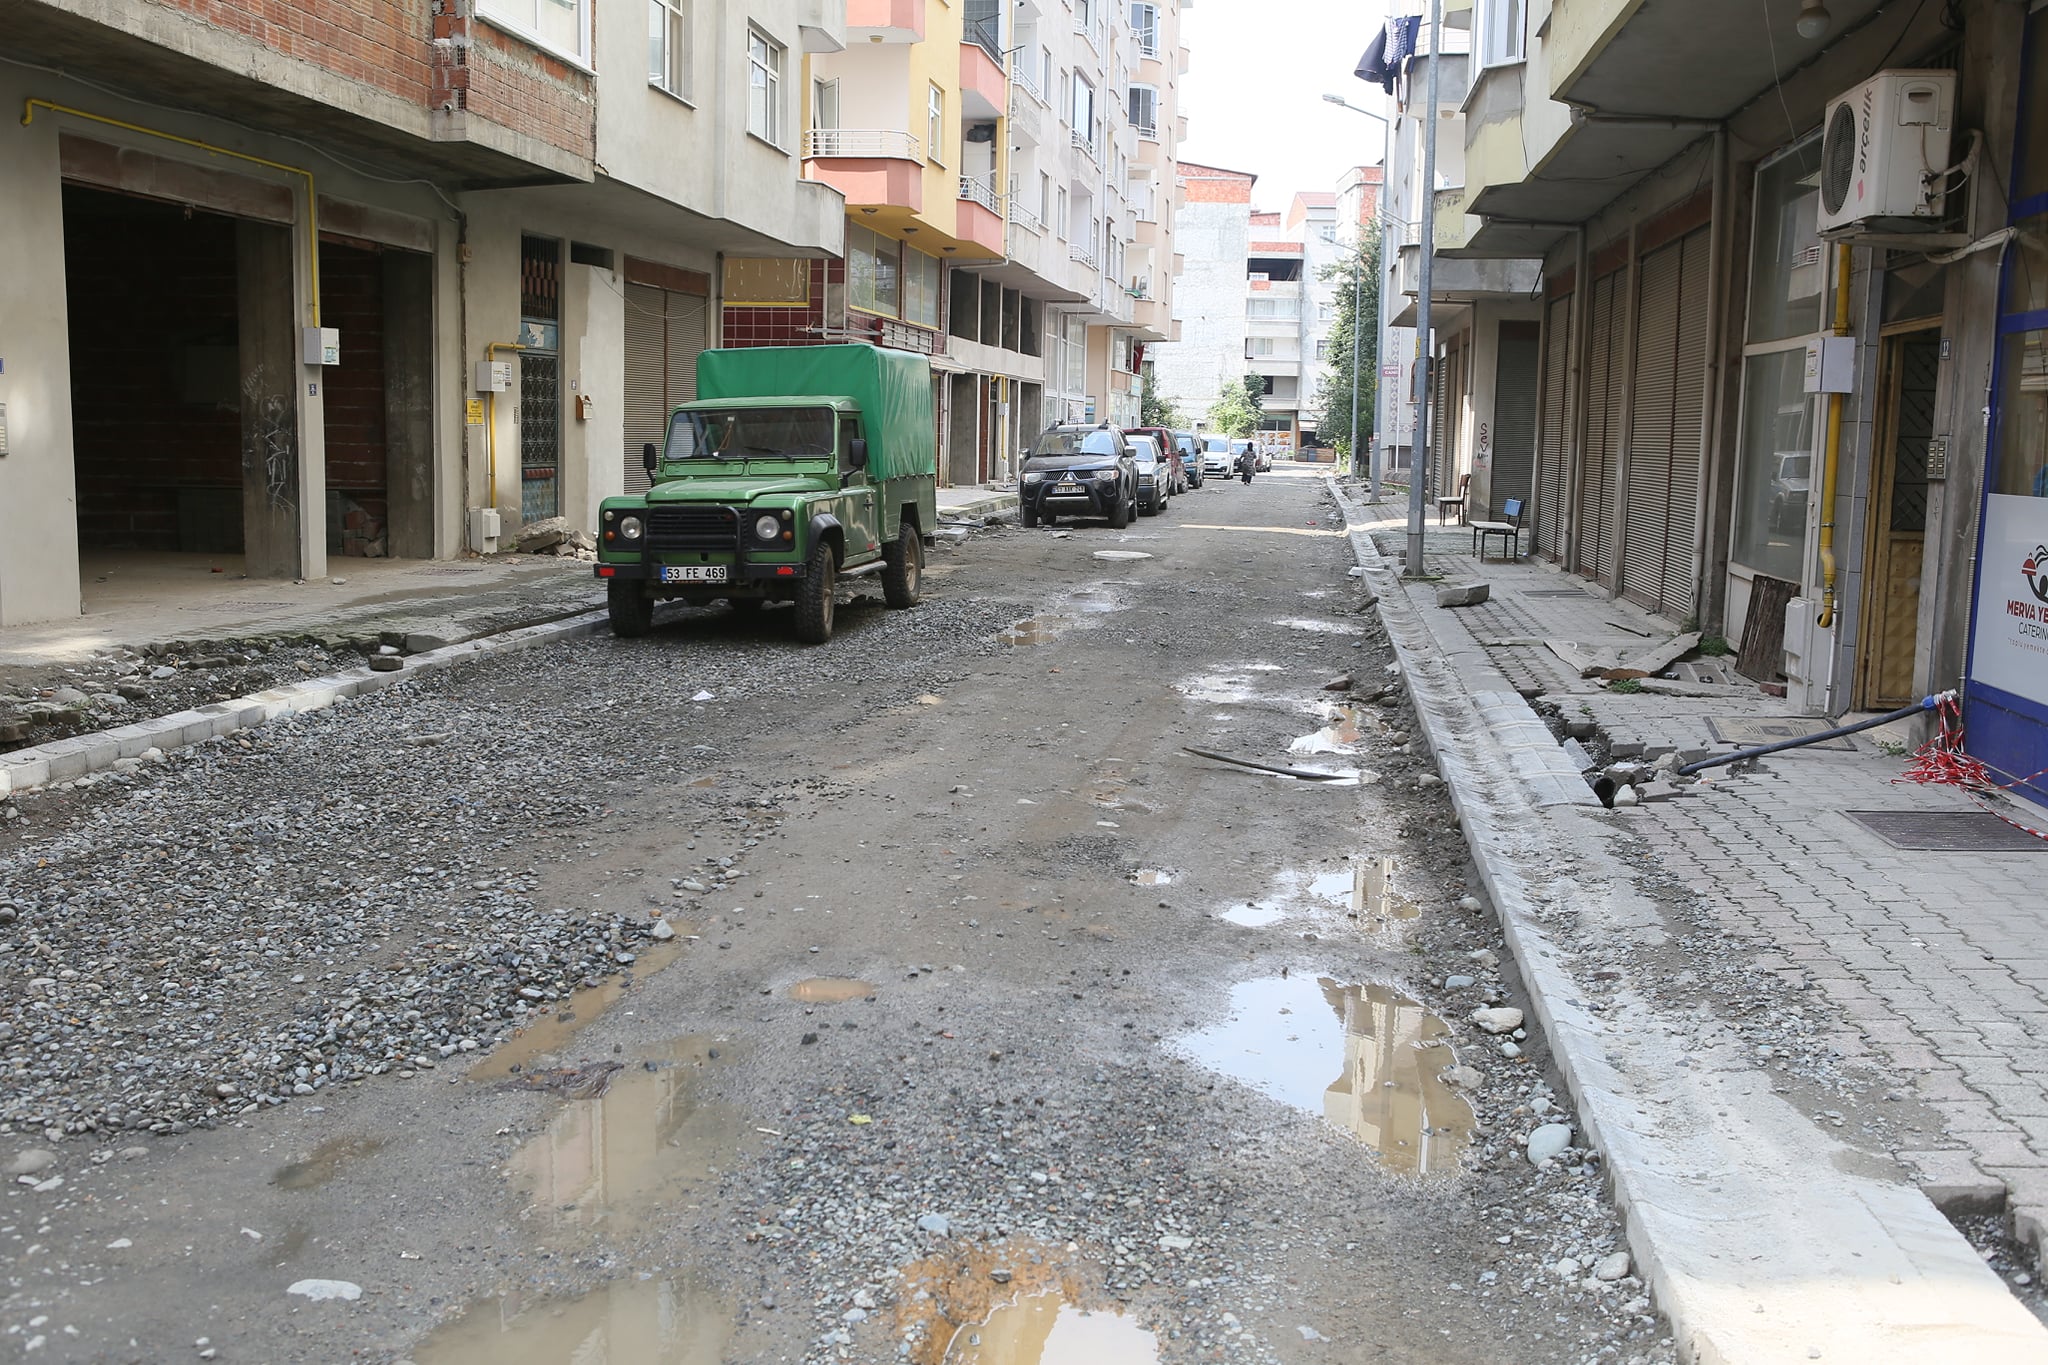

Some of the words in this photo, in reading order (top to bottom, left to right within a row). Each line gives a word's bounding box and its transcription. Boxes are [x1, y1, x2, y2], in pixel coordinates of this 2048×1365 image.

[1860, 87, 1873, 174] arçelik
[666, 568, 680, 579] 53
[686, 567, 699, 578] FE
[705, 567, 725, 578] 469
[2007, 599, 2036, 621] MERVA
[2018, 622, 2048, 640] CATERIN
